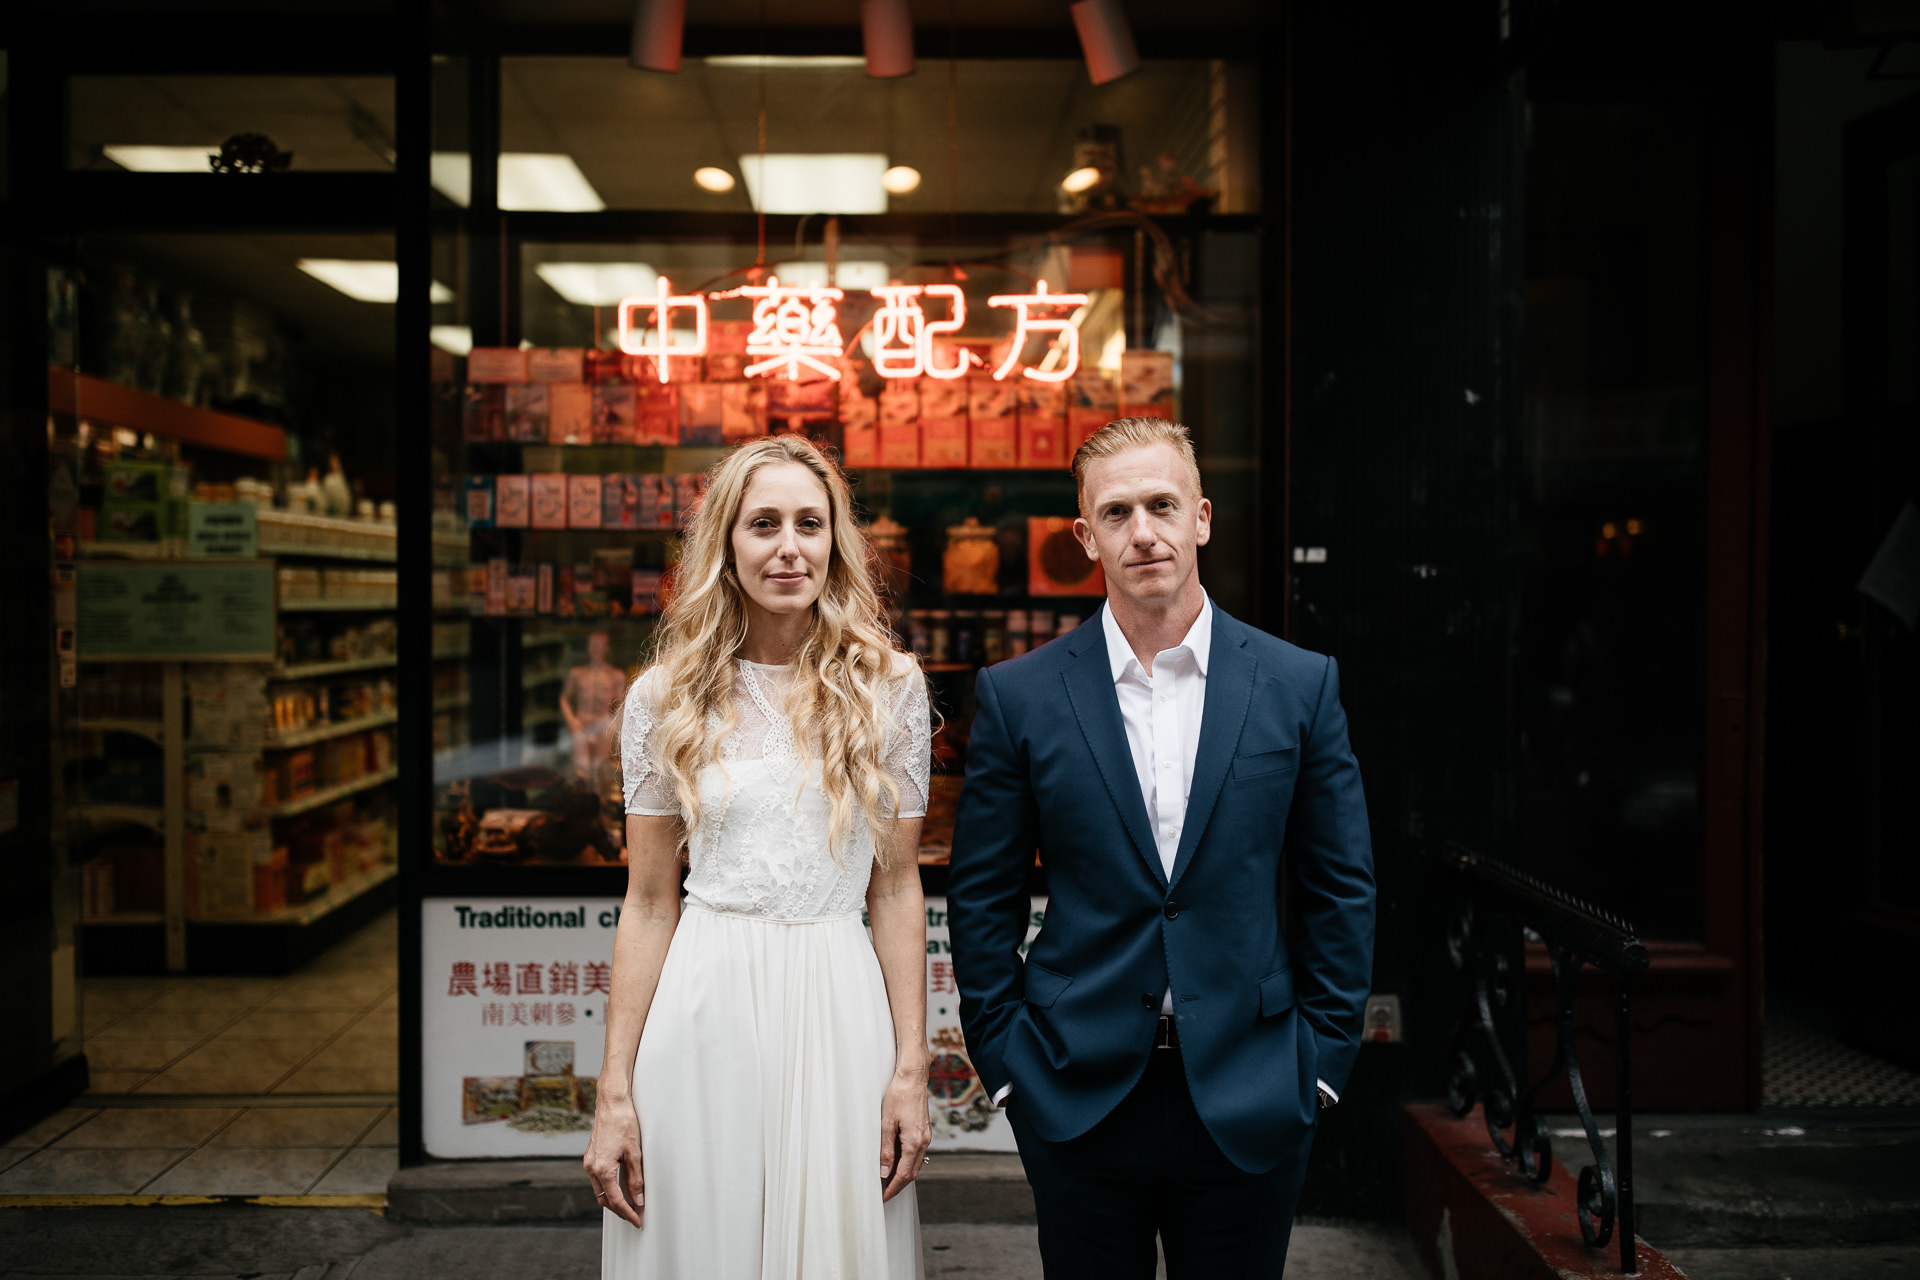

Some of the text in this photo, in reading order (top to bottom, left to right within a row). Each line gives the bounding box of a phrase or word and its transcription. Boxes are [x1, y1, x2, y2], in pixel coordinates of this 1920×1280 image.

[617, 274, 1090, 384] 中藥配方
[454, 905, 586, 929] Traditional
